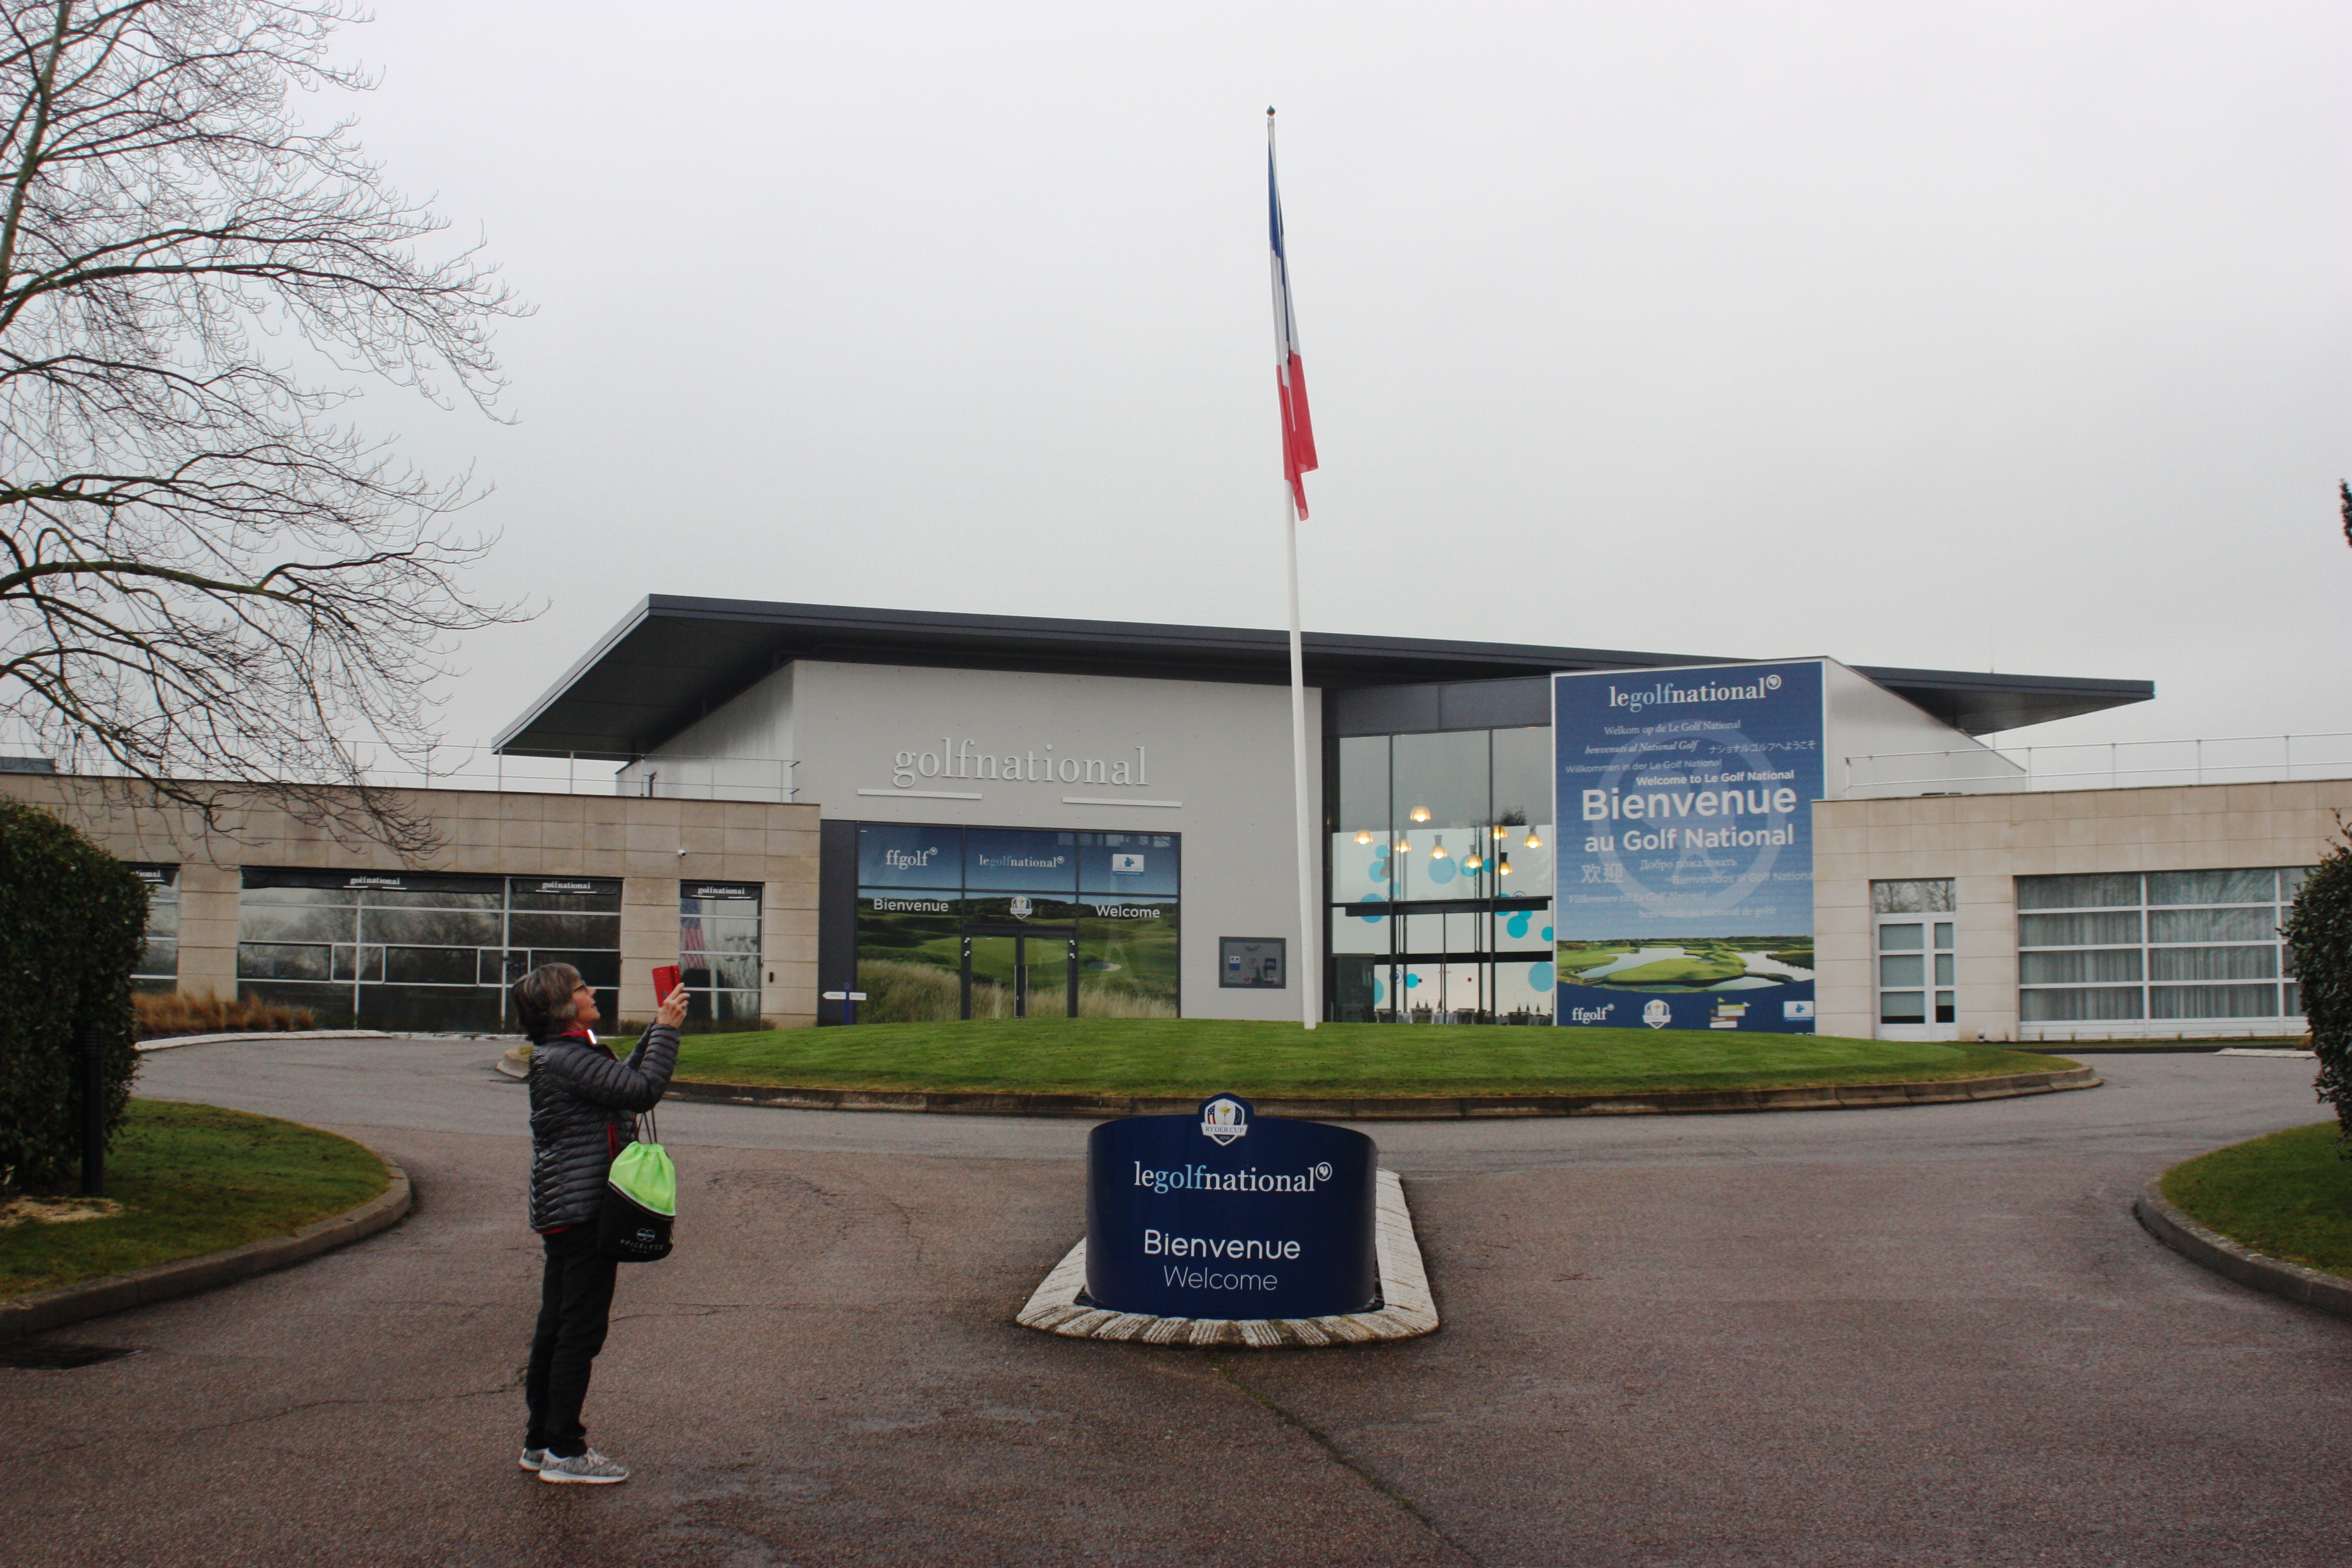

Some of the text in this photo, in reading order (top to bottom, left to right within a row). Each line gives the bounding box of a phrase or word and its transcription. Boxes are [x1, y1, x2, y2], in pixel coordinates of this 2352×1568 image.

[1609, 677, 1766, 712] legolfnational
[1604, 719, 1741, 736] Welkom op de Le Golf National
[1585, 740, 1700, 754] benvenuti al National Golf
[892, 738, 1149, 787] golfnational
[1565, 758, 1722, 774] Willkommen in der Le Golf National
[1636, 770, 1794, 786] Welcome to Le Golf National
[1583, 786, 1796, 821] Bienvenue
[1585, 824, 1794, 853] au Golf National
[885, 849, 931, 870] ffgolf
[979, 854, 1057, 869] legolfnational
[1640, 859, 1738, 871] Добро пожаловать
[1581, 863, 1624, 884] 欢迎
[1738, 873, 1746, 882] al
[1749, 872, 1771, 881] Golf
[1773, 871, 1814, 881] Nationa
[542, 881, 591, 890] golfnational
[698, 886, 745, 895] golfnational
[1634, 892, 1644, 902] Le
[1646, 891, 1665, 903] Golf
[873, 899, 949, 912] Bienvenue
[1096, 905, 1160, 918] Welcome
[1572, 1007, 1608, 1024] ffgolf
[1134, 1161, 1315, 1194] legolfnational
[1144, 1229, 1300, 1260] Bienvenue
[1164, 1266, 1278, 1291] Welcome
